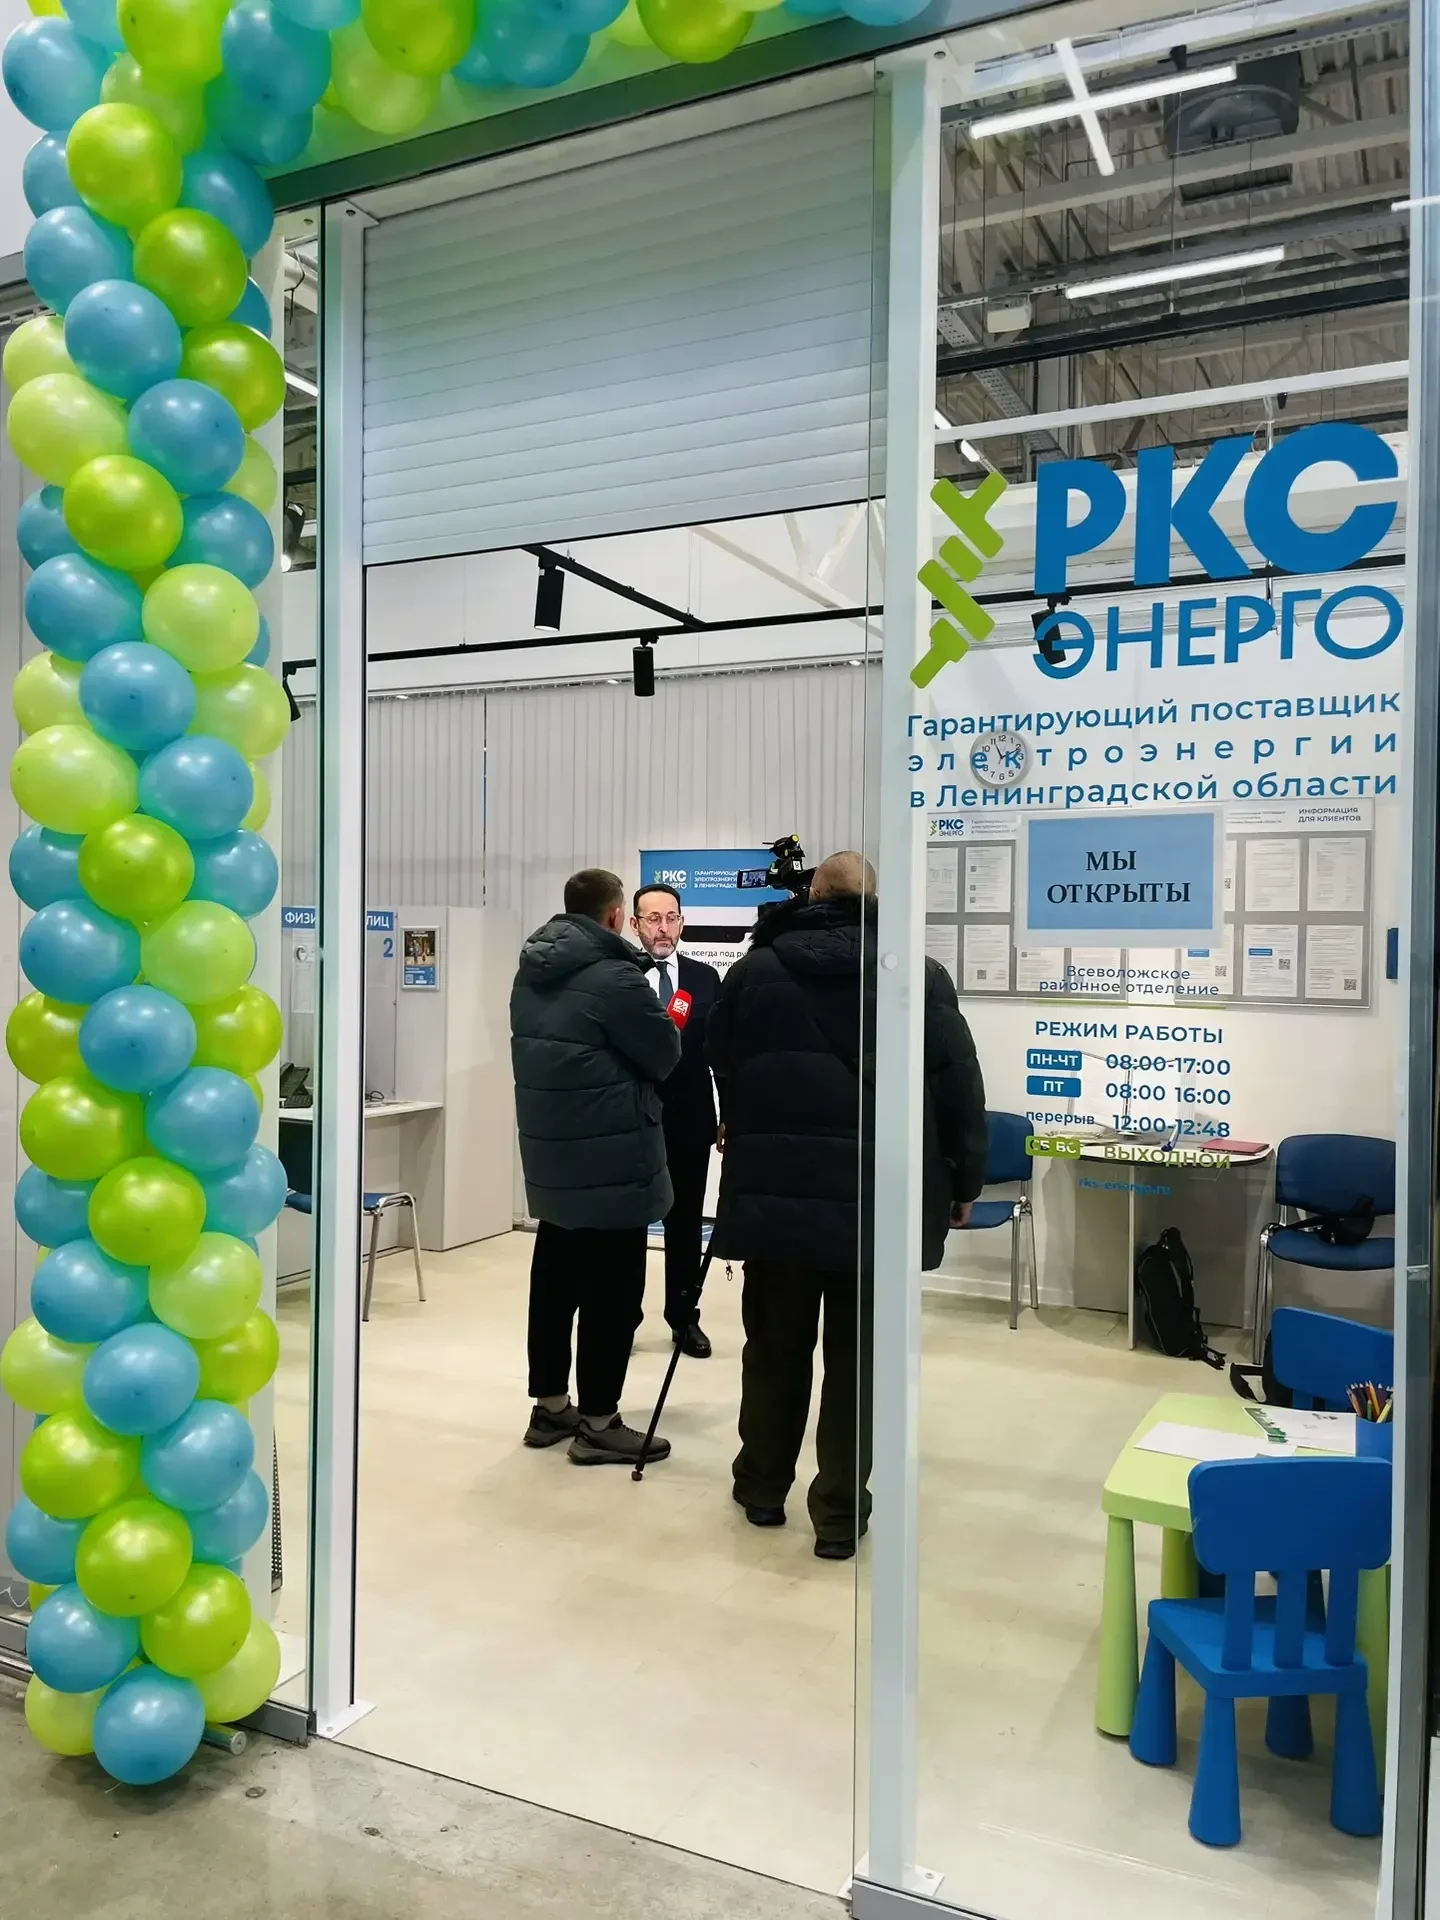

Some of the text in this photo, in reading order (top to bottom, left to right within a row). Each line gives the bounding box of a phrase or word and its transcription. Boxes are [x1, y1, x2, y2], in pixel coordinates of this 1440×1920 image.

[1034, 422, 1398, 594] РКС
[1033, 585, 1404, 679] ЭНЕРГО
[907, 692, 1400, 740] Гарантирующий поставщик
[911, 771, 1396, 808] в Ленинградской области
[939, 819, 964, 829] РКС
[1086, 850, 1136, 871] МЫ
[663, 870, 687, 882] РКС
[1047, 882, 1191, 903] ОТКРЫТЫ
[366, 915, 390, 929] ЛИЦ
[383, 937, 393, 958] 2
[1067, 965, 1190, 980] Всеволожское
[1039, 979, 1219, 996] районное отделение
[1035, 1021, 1223, 1044] РЕЖИМ РАБОТЫ
[1030, 1053, 1231, 1076] ПН-ЧТ 08:00-17:00
[1043, 1080, 1231, 1106] ПТ 08:00 16:00
[1026, 1111, 1231, 1138] перерыв 12:00-12:48
[1030, 1140, 1231, 1169] СБ ВС ВЫХОДНОЙ
